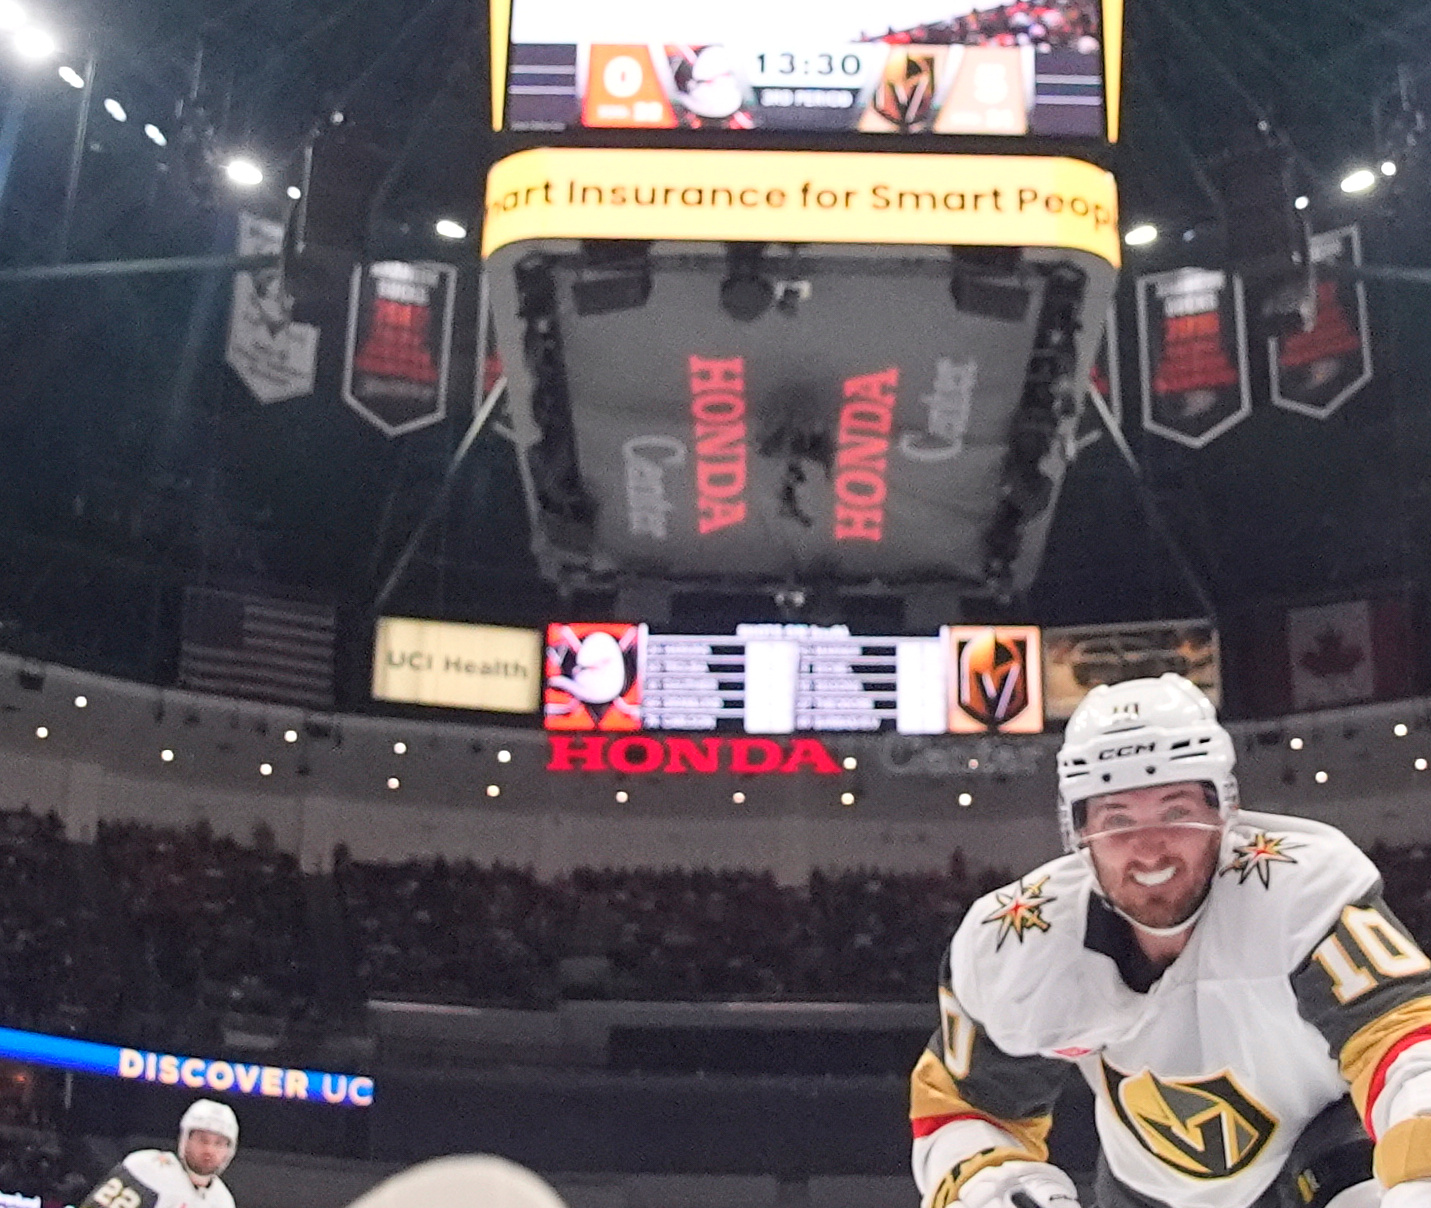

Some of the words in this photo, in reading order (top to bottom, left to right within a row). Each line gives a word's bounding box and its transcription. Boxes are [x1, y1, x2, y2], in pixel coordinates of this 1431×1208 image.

[757, 53, 861, 76] 13:30
[568, 180, 787, 208] Insurance
[801, 181, 858, 208] for
[871, 183, 1003, 211] Smart
[1019, 187, 1117, 231] Peop
[688, 353, 747, 535] HONDA
[833, 366, 900, 542] HONDA
[385, 651, 434, 676] UCI
[441, 655, 530, 682] Health
[544, 736, 844, 775] HONDA
[1098, 741, 1157, 761] CCM
[118, 1048, 310, 1102] DISCOVER
